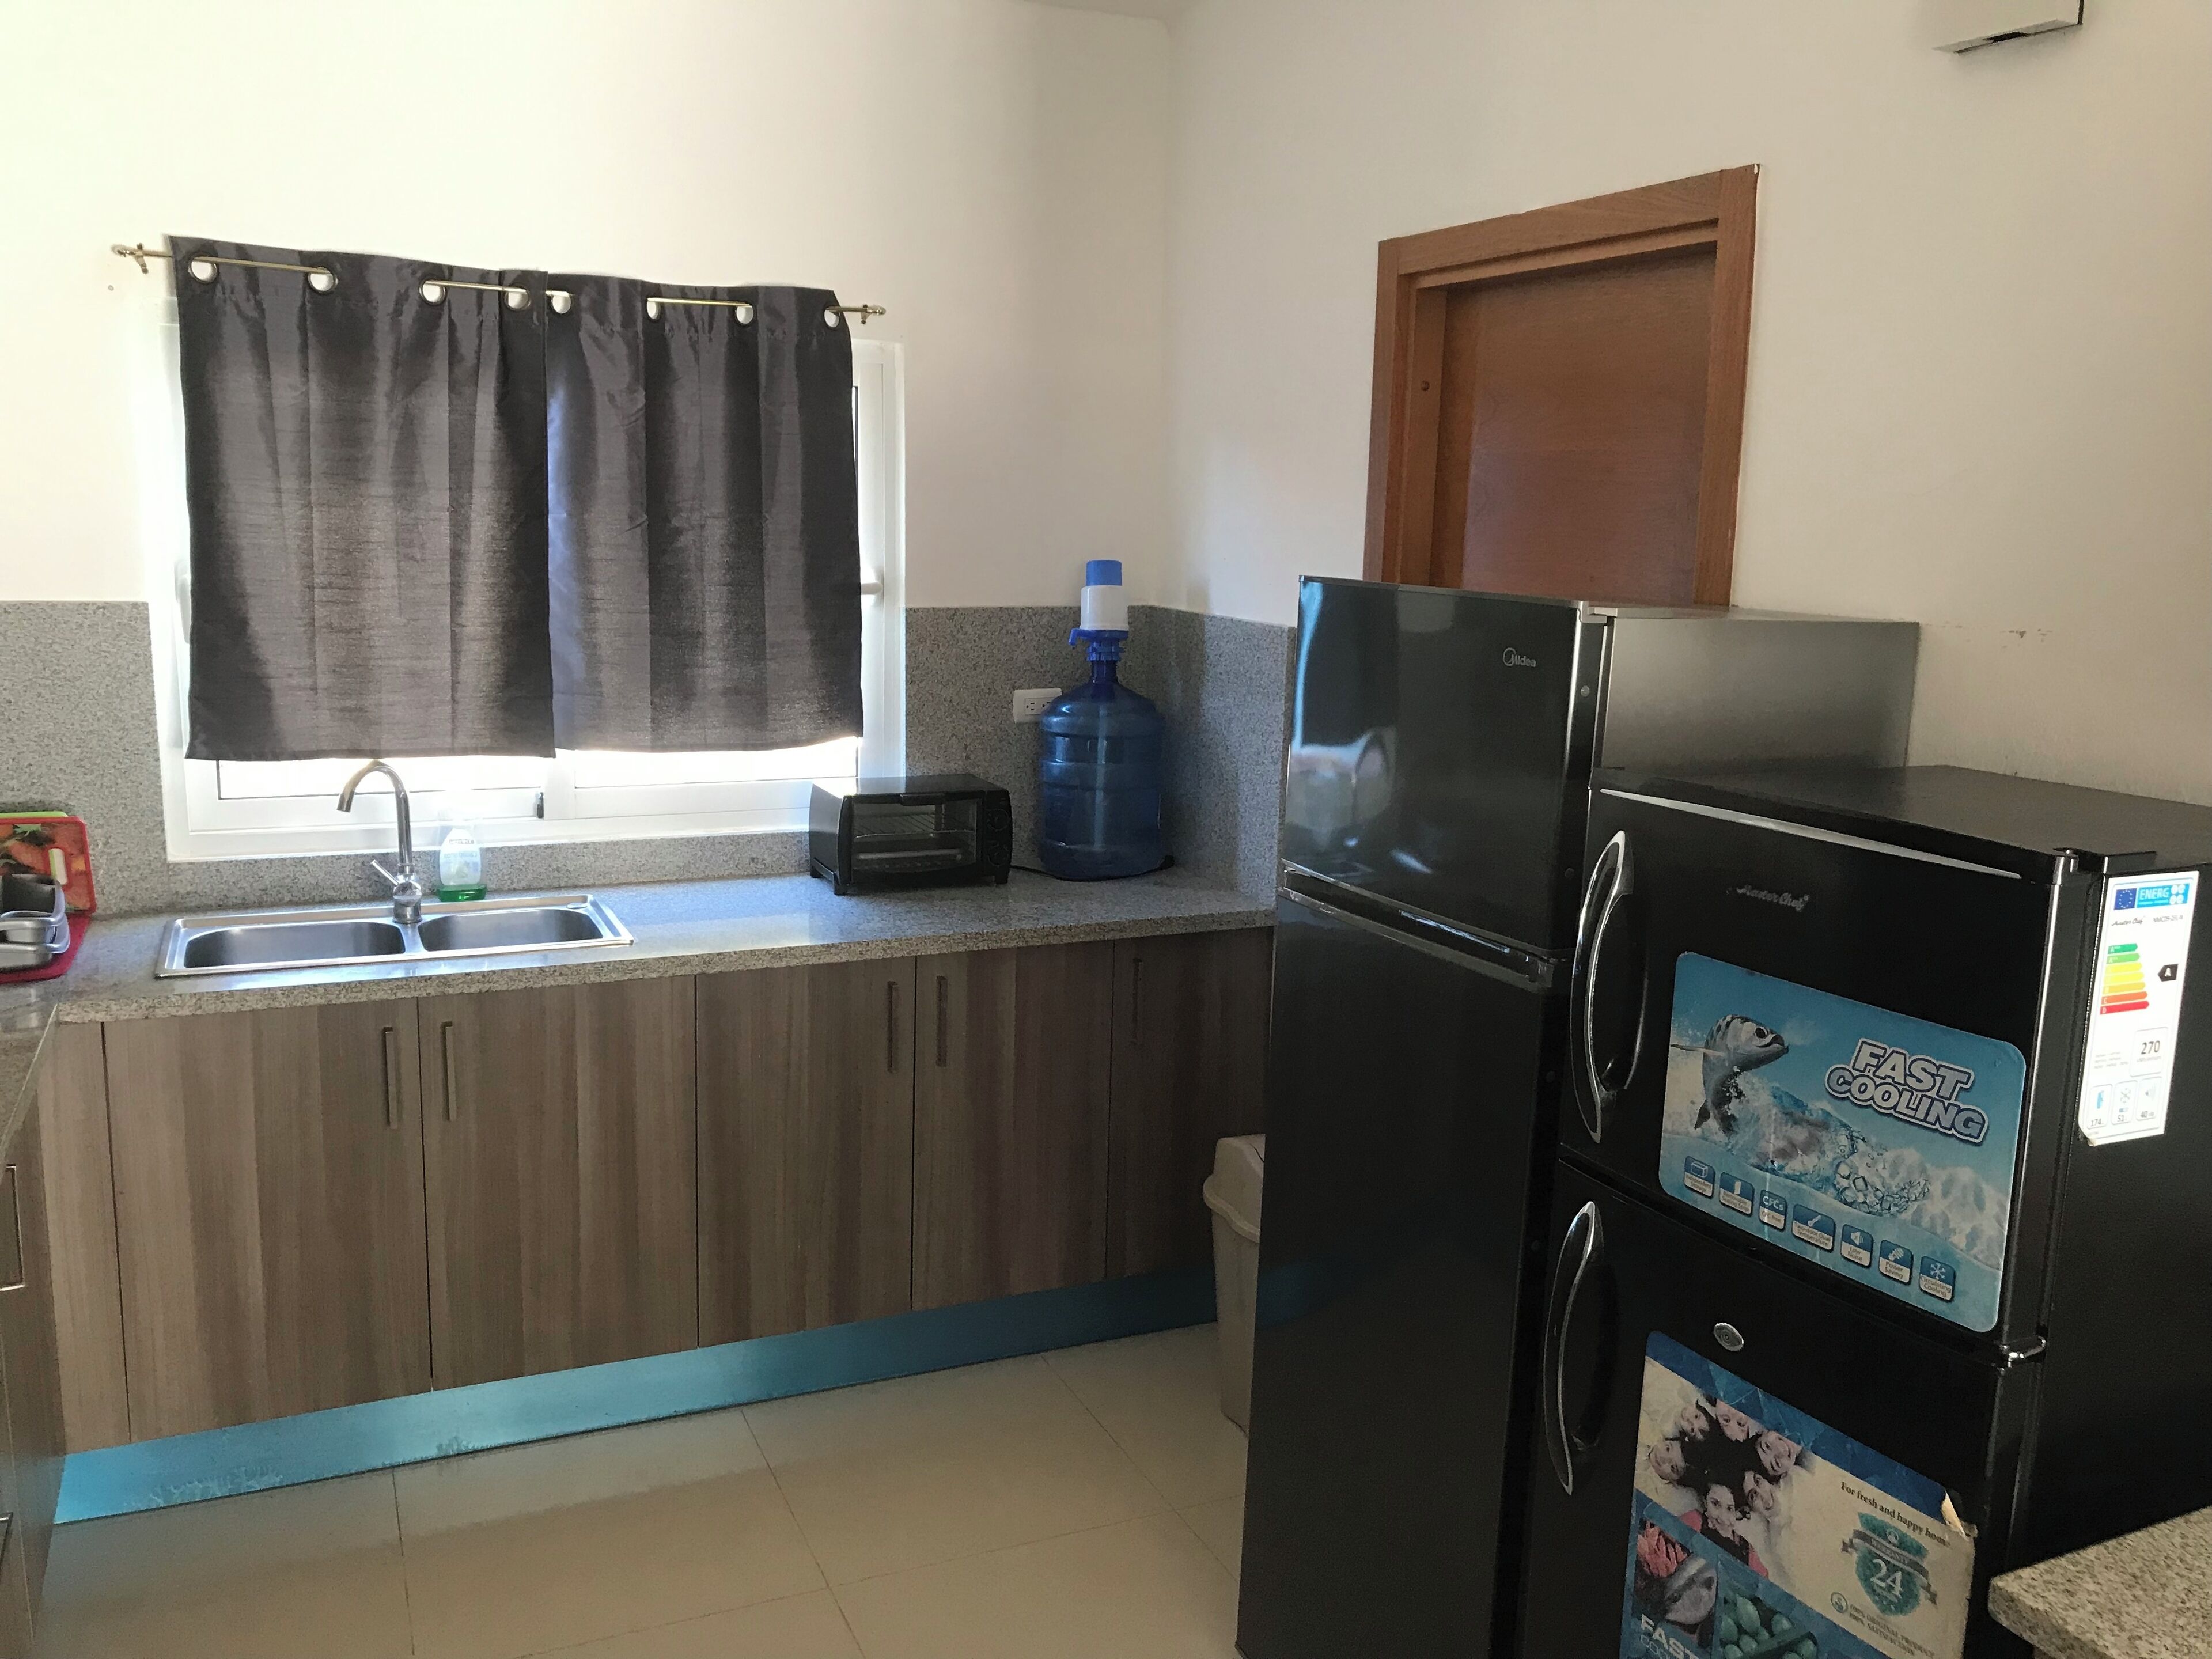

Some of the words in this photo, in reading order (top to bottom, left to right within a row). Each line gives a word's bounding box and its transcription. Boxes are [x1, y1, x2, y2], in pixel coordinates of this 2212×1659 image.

[1503, 647, 1536, 667] Midea
[2139, 888, 2169, 900] ENERG
[2164, 967, 2171, 977] A
[2141, 1040, 2160, 1055] 270
[1851, 1039, 1974, 1101] FAST
[1826, 1066, 1986, 1141] COOLING
[2090, 1118, 2101, 1127] 174
[1841, 1482, 1855, 1496] For
[1857, 1490, 1877, 1509] fresh
[1879, 1504, 1896, 1518] and
[1897, 1511, 1924, 1535] happy
[1870, 1558, 1902, 1599] 24
